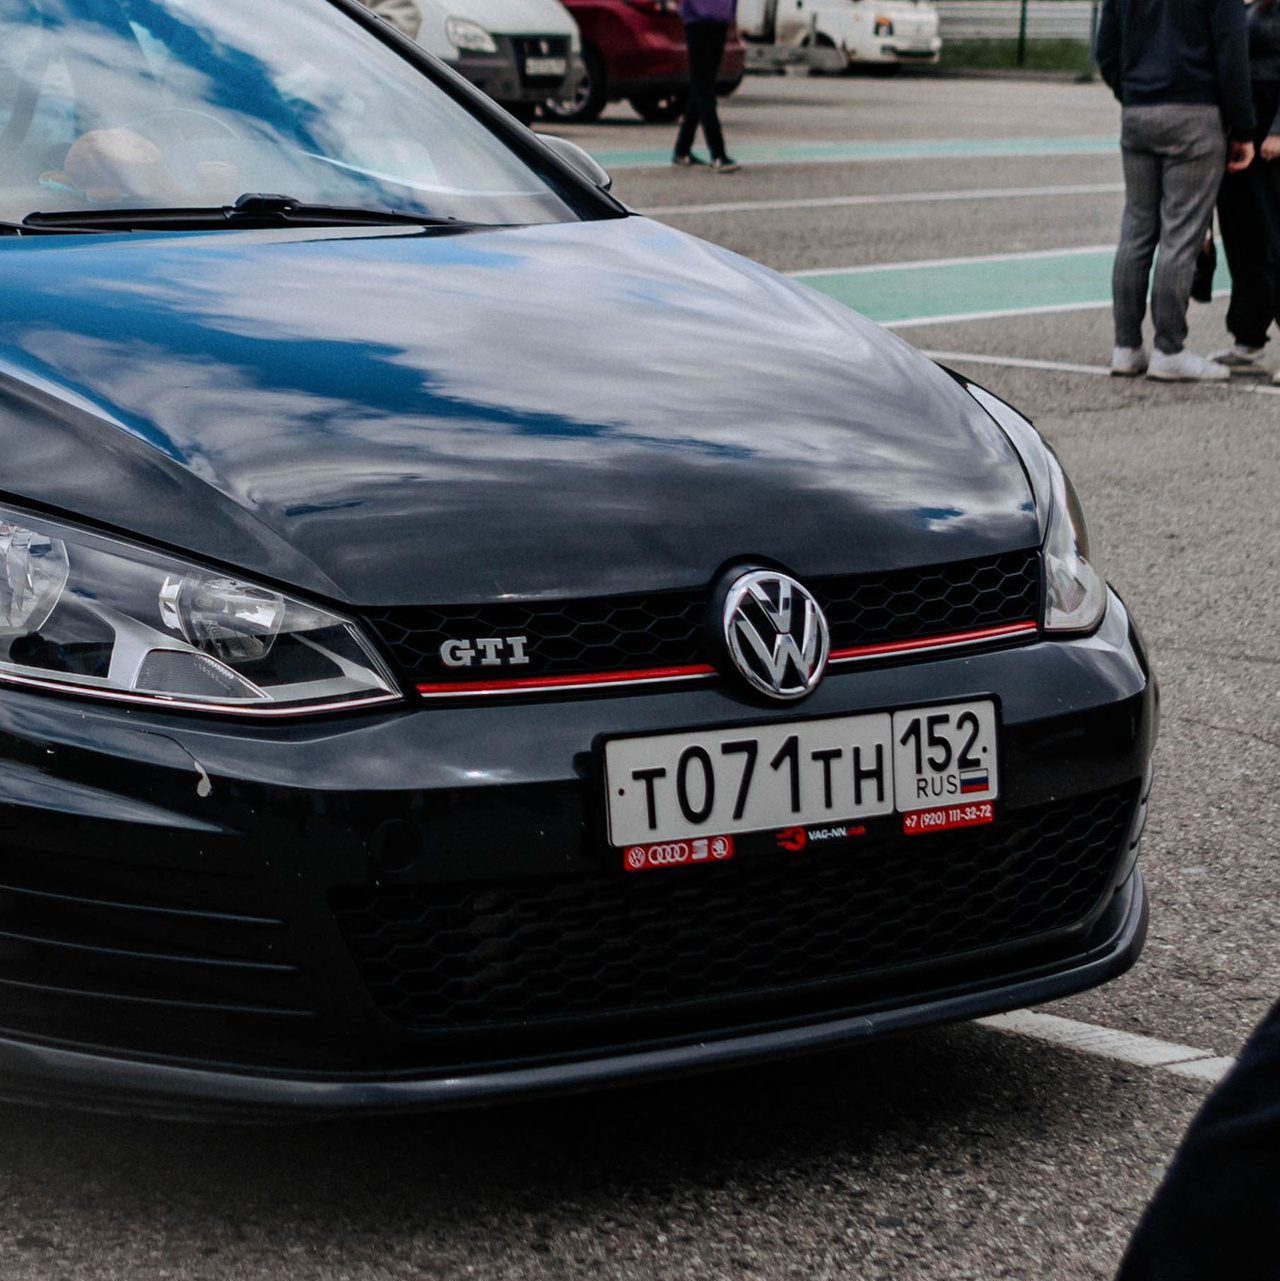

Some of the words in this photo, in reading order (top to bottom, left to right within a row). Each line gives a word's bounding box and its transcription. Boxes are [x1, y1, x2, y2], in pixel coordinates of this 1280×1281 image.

[440, 635, 529, 668] GTI
[899, 710, 982, 775] 152
[915, 774, 958, 799] RUS
[905, 815, 917, 828] +7
[920, 810, 946, 828] (920)
[949, 804, 992, 822] 111-32-72
